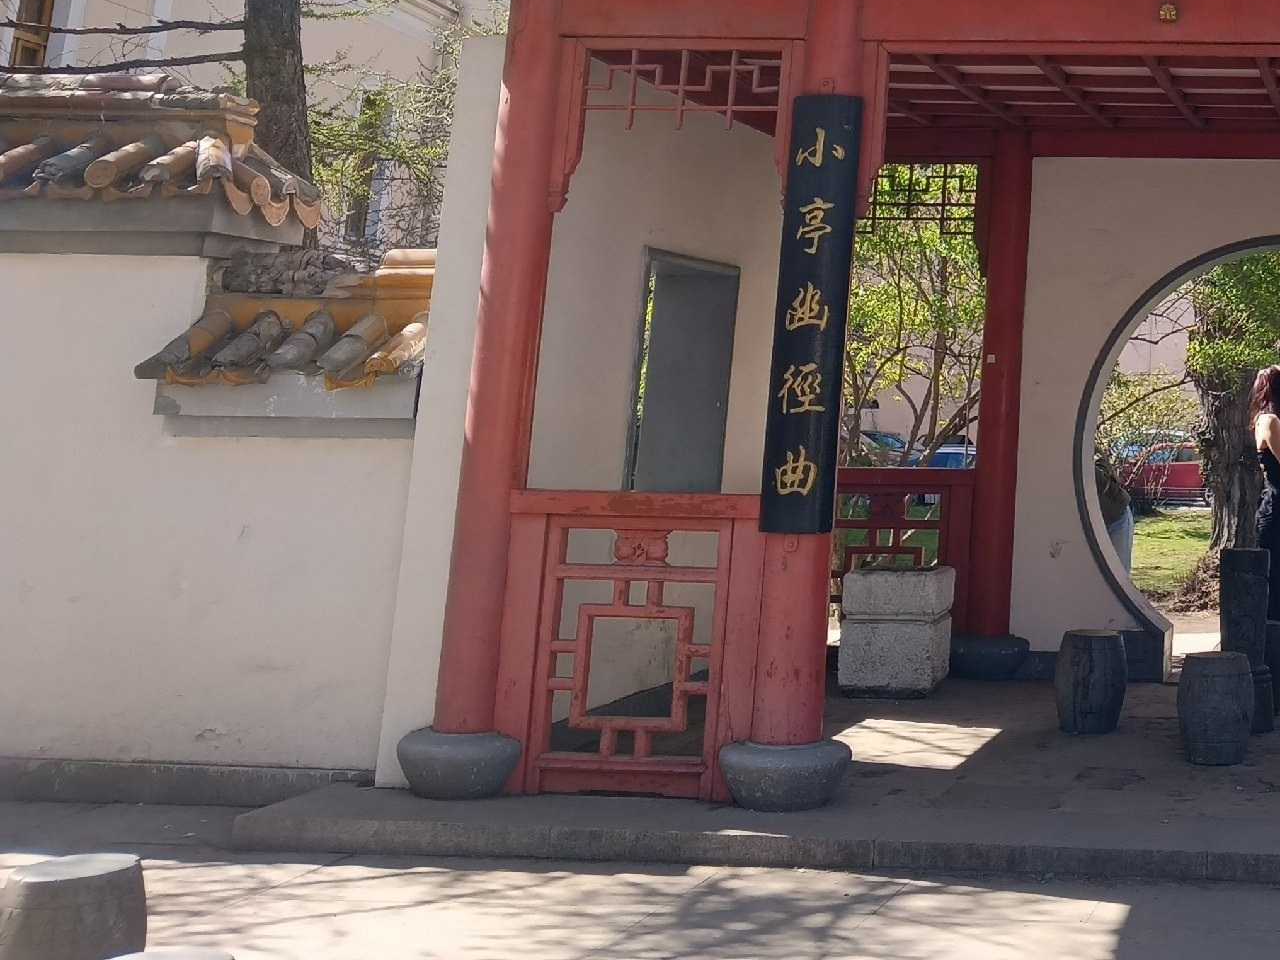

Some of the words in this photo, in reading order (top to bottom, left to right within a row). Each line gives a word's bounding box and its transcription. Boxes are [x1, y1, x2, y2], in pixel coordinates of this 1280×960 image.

[775, 127, 846, 496] 小亭幽徑曲
